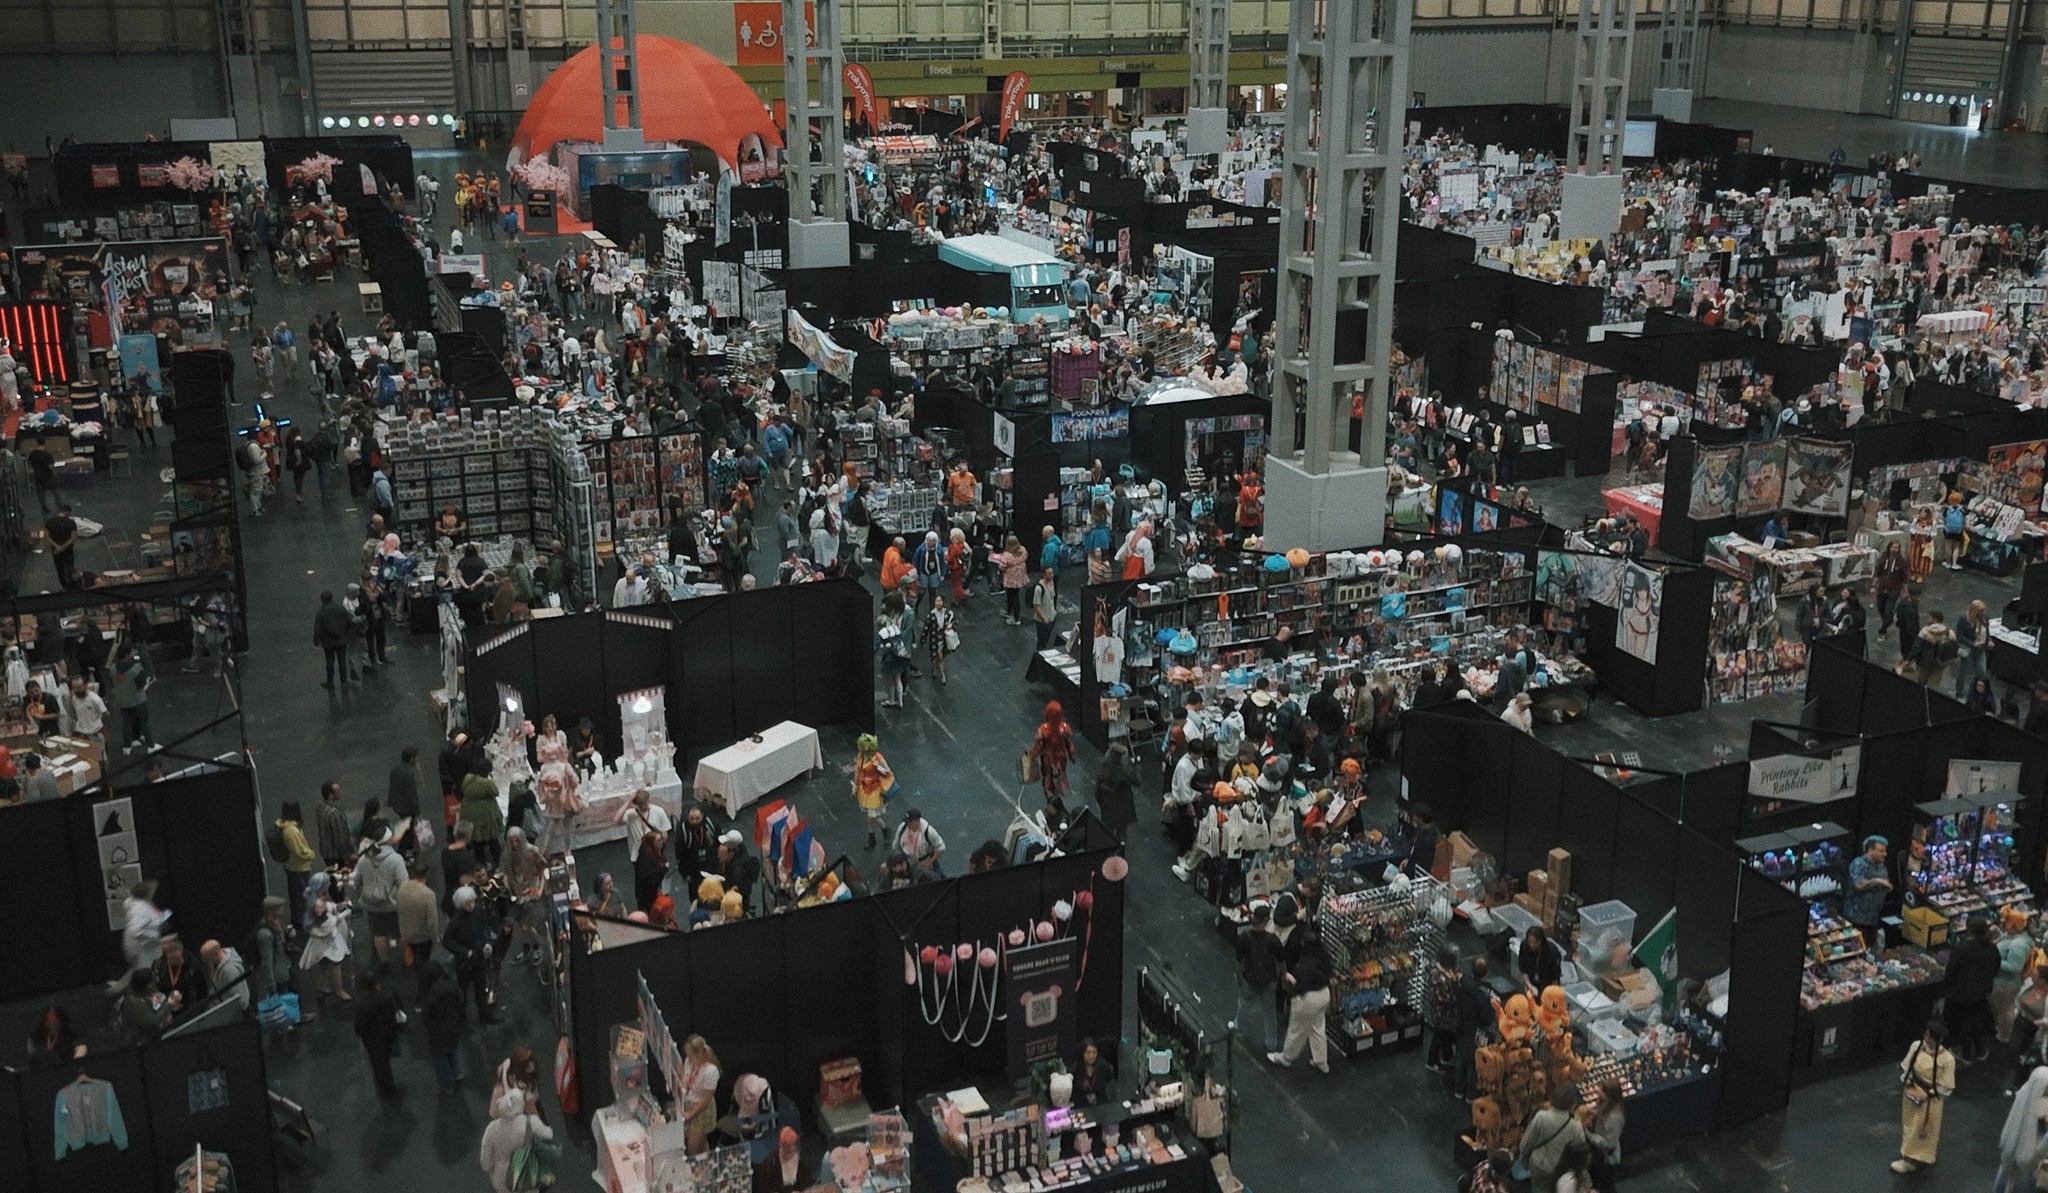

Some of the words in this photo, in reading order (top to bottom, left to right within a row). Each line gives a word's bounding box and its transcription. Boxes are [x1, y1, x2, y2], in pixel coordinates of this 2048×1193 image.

[100, 252, 147, 277] Asian
[1761, 767, 1800, 784] Printing
[1803, 761, 1824, 775] Like
[1773, 779, 1809, 796] Rabbits
